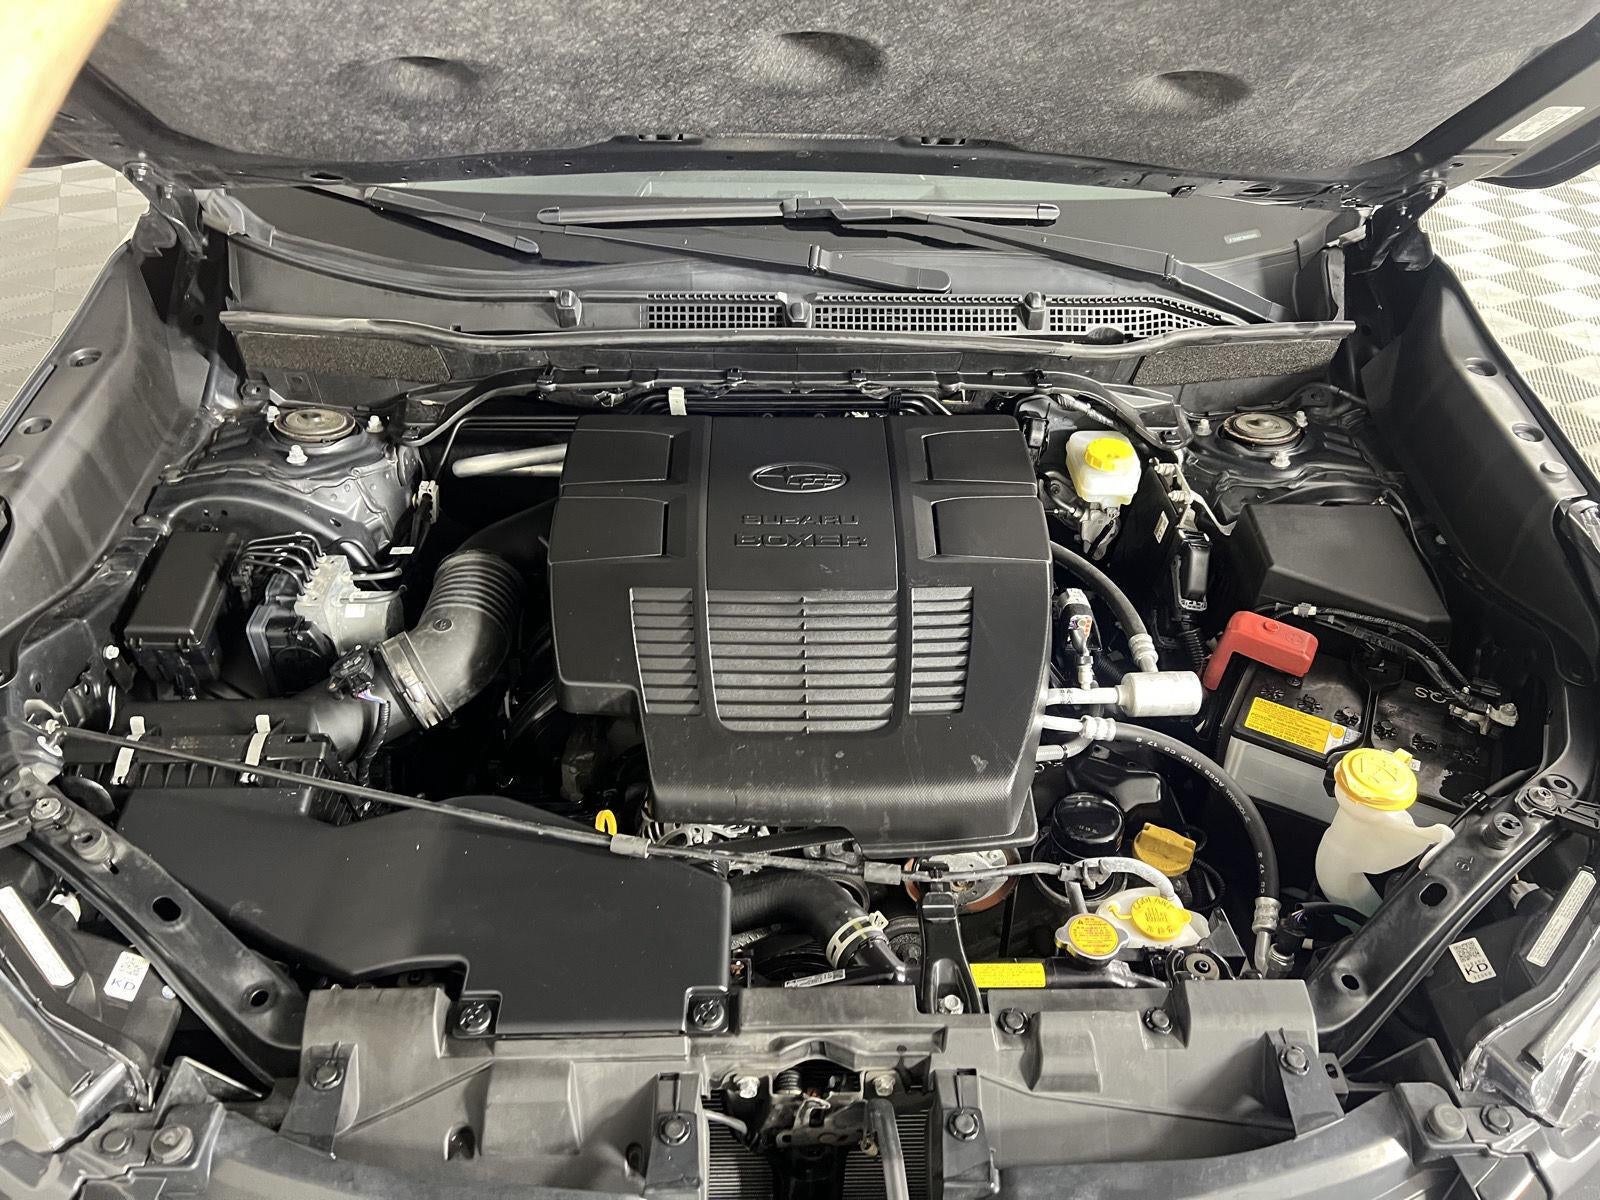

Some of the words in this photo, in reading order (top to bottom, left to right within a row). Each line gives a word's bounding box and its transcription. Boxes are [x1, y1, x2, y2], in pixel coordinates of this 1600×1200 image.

[742, 514, 860, 526] SUBARU
[734, 533, 869, 548] BOXER
[1251, 713, 1272, 722] POISON
[1181, 755, 1193, 763] HP
[1464, 962, 1489, 976] KD
[111, 978, 136, 991] KD
